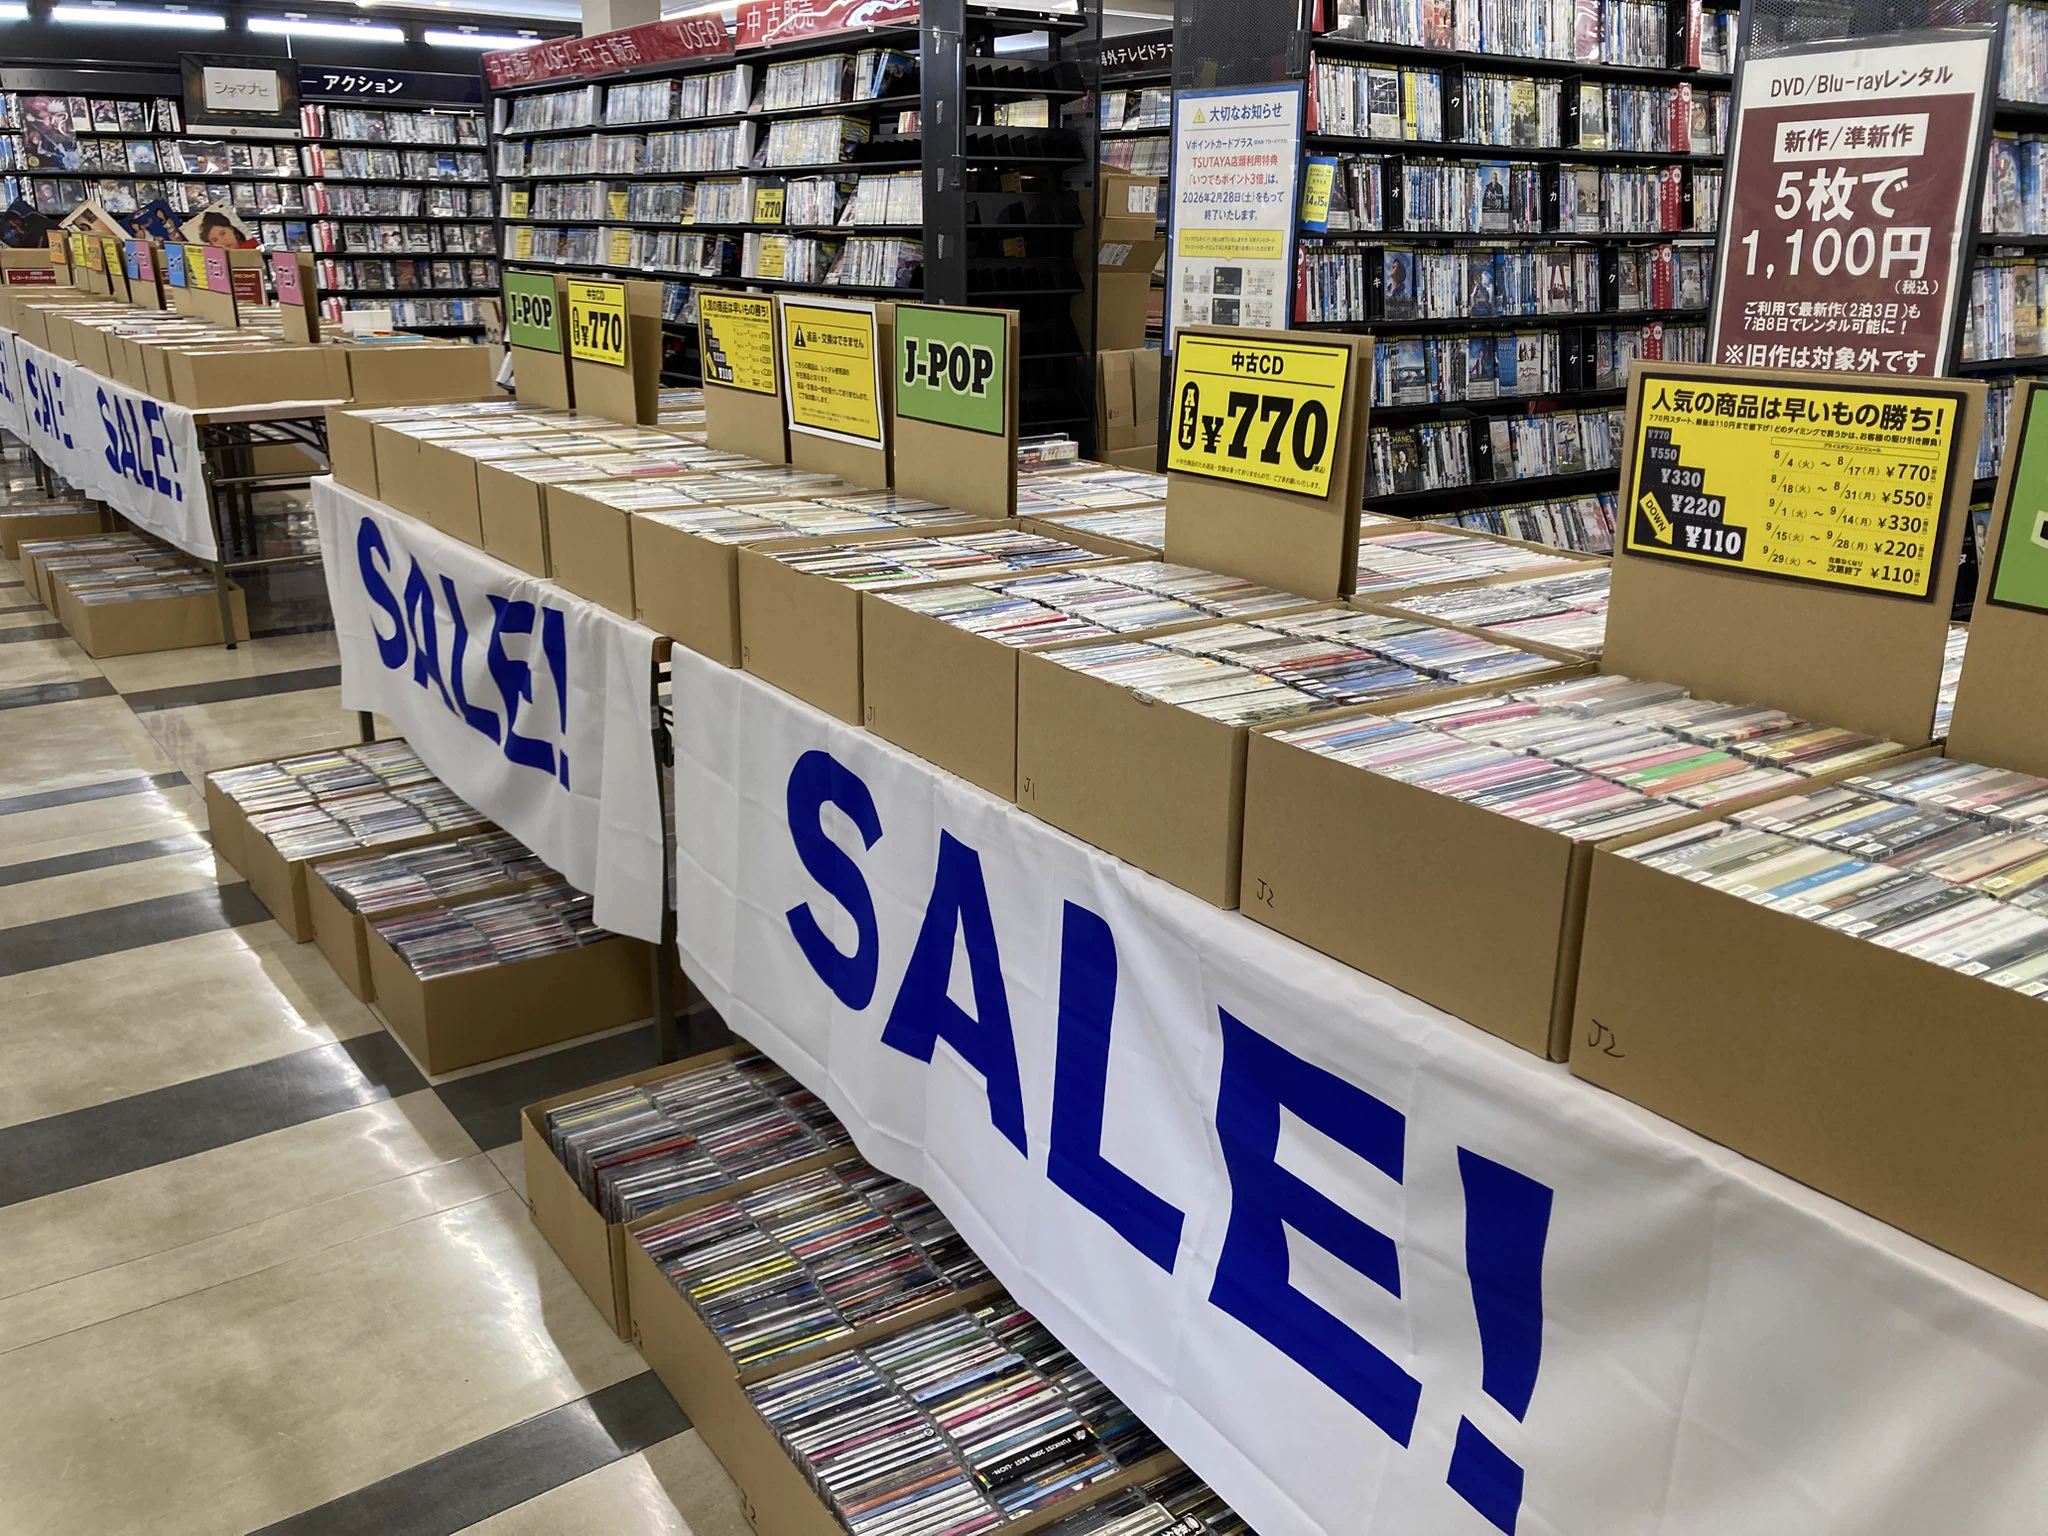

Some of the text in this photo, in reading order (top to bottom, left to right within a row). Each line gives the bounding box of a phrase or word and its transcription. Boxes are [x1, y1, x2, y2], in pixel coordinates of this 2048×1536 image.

[577, 20, 721, 70] 中古販売 USED
[322, 74, 403, 94] アクション
[1769, 65, 1953, 98] DVD/Blu-rayレンタル
[1209, 102, 1283, 122] 大切なお知らせ
[1784, 122, 1915, 153] 新作/準新作
[1192, 155, 1278, 168] TSUTAYA店頭利用特典
[1774, 167, 1909, 222] 5枚で
[1741, 227, 1932, 281] 1,100円
[510, 292, 553, 328] J-POP
[581, 311, 622, 353] ¥770
[903, 337, 993, 398] J-POP
[1231, 351, 1284, 375] 中古CD
[1182, 388, 1196, 444] ALL
[1652, 387, 1944, 435] 人気の商品は早いもの勝ち!
[97, 386, 183, 502] SALE!
[1201, 391, 1328, 472] ¥770
[1647, 429, 1670, 440] ¥770
[1480, 444, 1488, 454] サ
[1650, 447, 1677, 460] ¥550
[1661, 468, 1701, 487] ¥330
[1886, 463, 1930, 482] ¥770
[1671, 494, 1721, 518] ¥220
[1881, 489, 1926, 508] ¥550
[1645, 500, 1666, 532] DOWN
[1878, 514, 1922, 534] ¥330
[1685, 525, 1741, 555] ¥110
[1874, 540, 1918, 559] ¥220
[1870, 565, 1914, 584] ¥110
[357, 516, 570, 792] SALE!
[1256, 878, 1275, 908] J2
[1588, 1018, 1627, 1058] J2
[786, 750, 1555, 1536] SALE!
[1014, 1454, 1031, 1467] BEST
